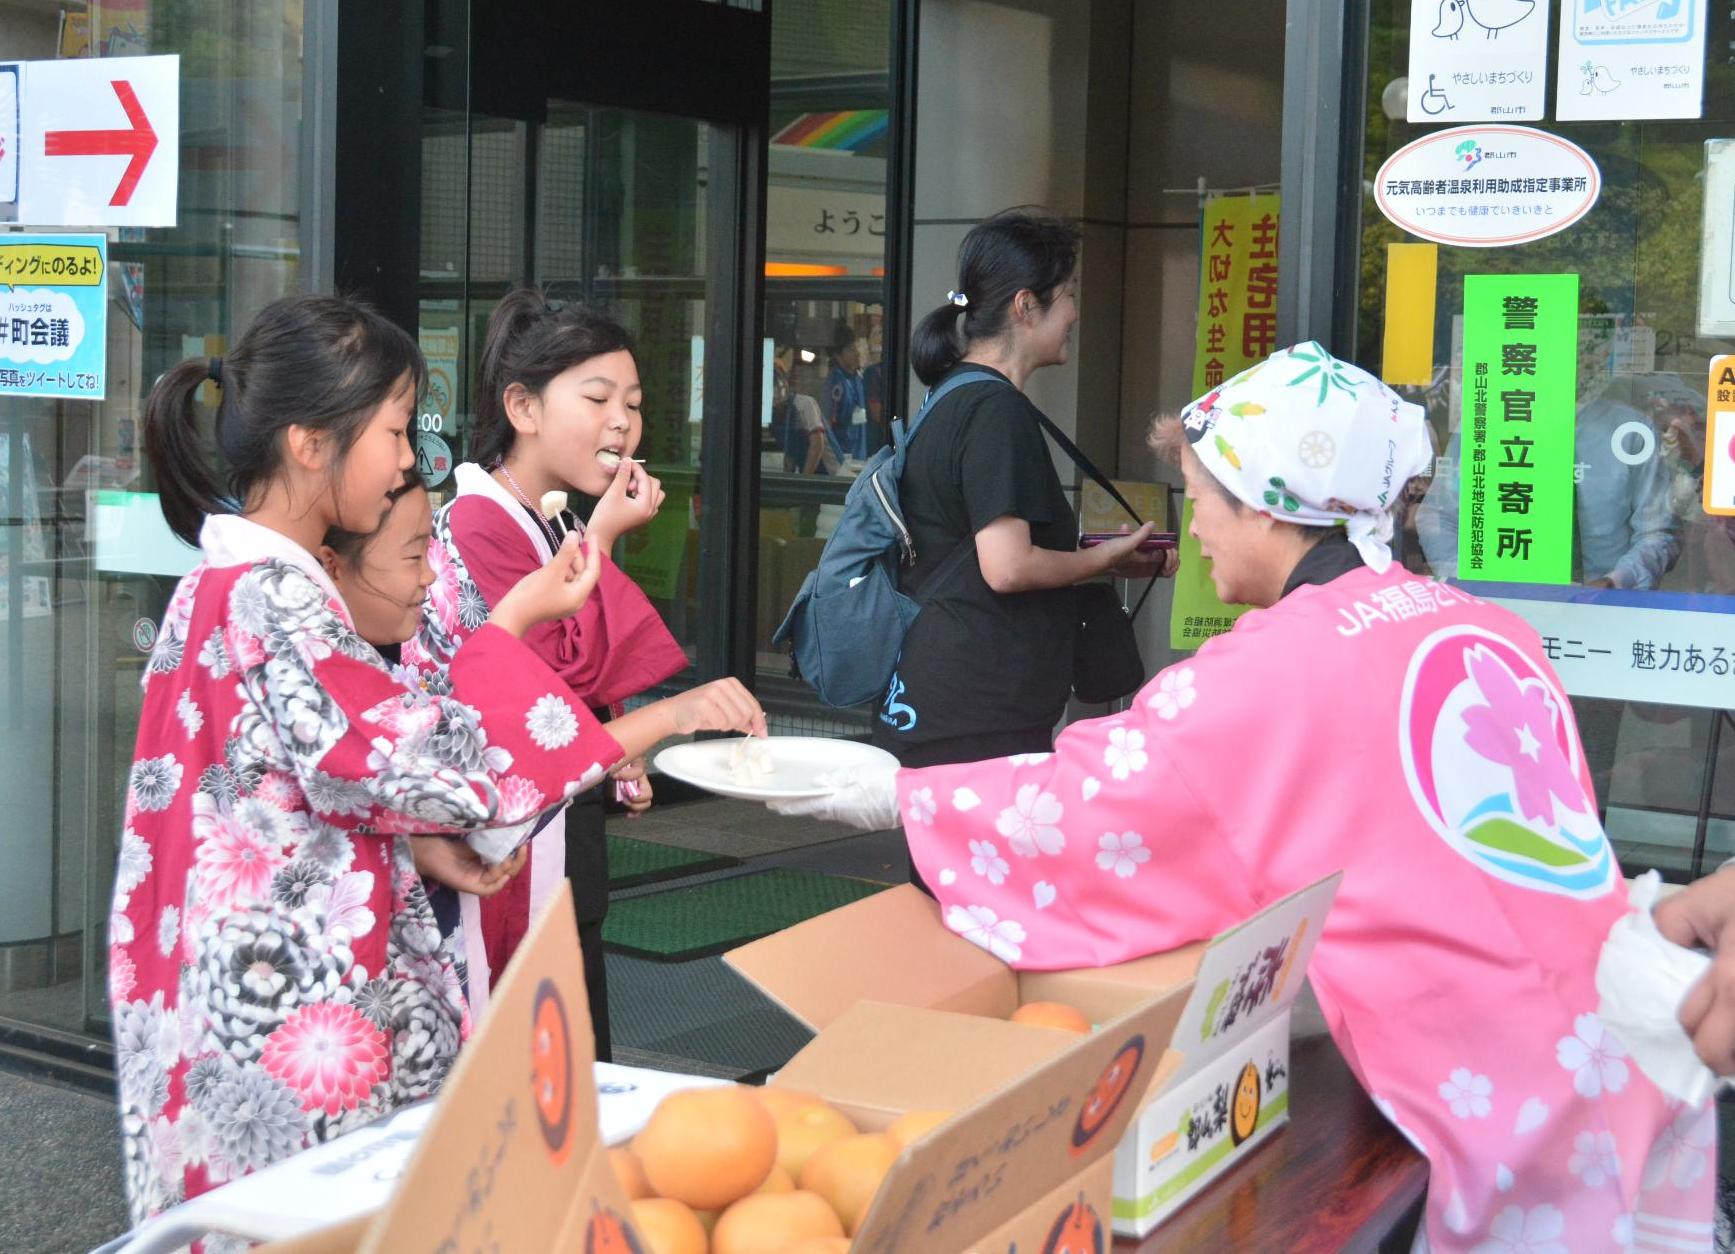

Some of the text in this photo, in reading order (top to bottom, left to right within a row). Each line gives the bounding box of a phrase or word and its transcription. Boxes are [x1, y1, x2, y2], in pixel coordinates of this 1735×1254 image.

[1630, 65, 1690, 76] やさしいまちづくり
[1452, 71, 1533, 85] やさしいまちづくり
[1386, 176, 1587, 196] 元気高齢者温泉利用助成指定事業所
[1416, 205, 1553, 216] いつまでも健康でいきいきと
[9, 303, 52, 312] ハッシュタグは
[1716, 389, 1735, 402] 設
[1496, 296, 1538, 560] 警察官立寄所
[1470, 362, 1488, 570] 郡山北警察署・郡山北地区防犯協会
